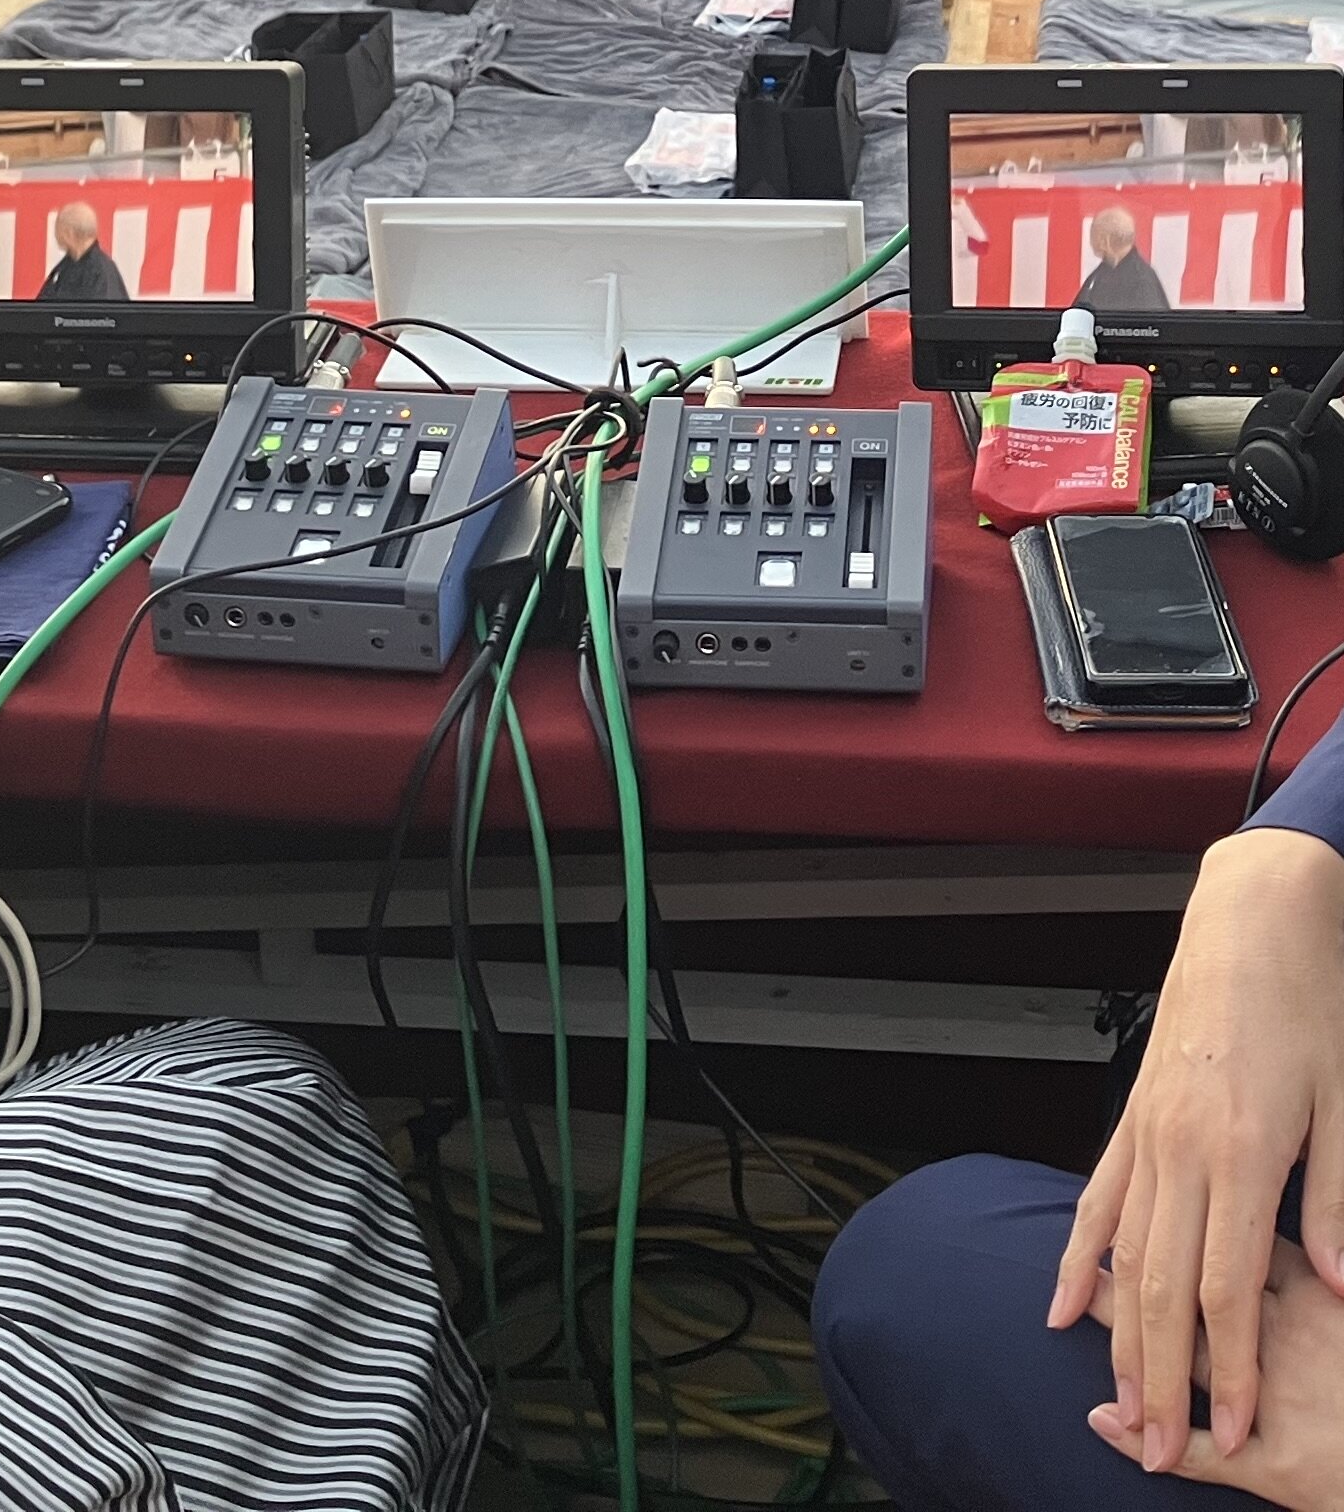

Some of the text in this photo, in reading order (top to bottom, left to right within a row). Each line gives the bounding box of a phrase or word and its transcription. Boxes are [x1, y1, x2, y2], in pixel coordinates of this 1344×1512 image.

[54, 314, 116, 329] Panasonic
[1094, 325, 1160, 338] Panasonic
[1062, 411, 1112, 431] 予防に
[426, 425, 449, 437] ON
[859, 441, 881, 452] ON
[1111, 428, 1138, 489] balance
